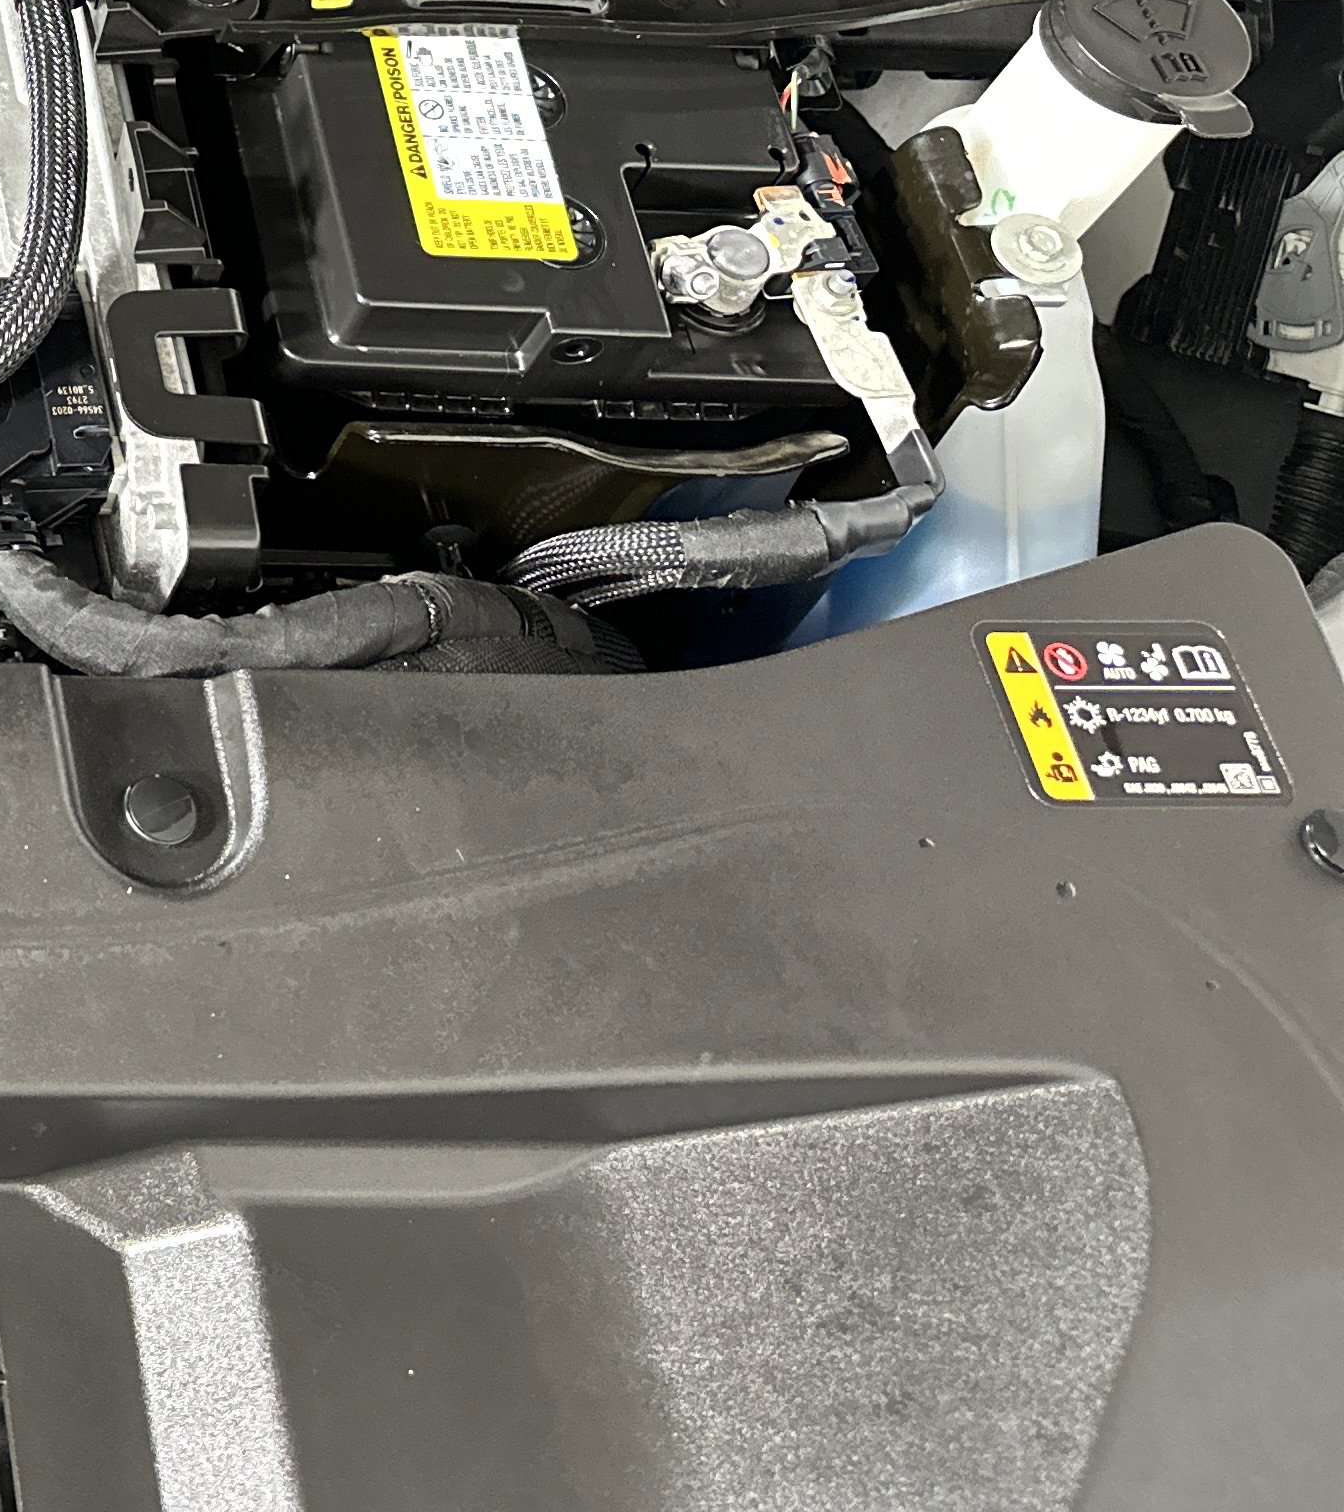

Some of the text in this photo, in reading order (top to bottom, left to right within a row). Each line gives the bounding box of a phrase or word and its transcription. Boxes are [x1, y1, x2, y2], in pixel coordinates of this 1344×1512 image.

[381, 47, 422, 161] DANGER/POISON
[66, 396, 88, 404] 2793
[52, 406, 103, 415] 34566-0203
[1104, 667, 1136, 680] AUTO
[1174, 708, 1214, 723] 0.700
[1214, 708, 1236, 726] kg
[1128, 756, 1161, 773] PAG
